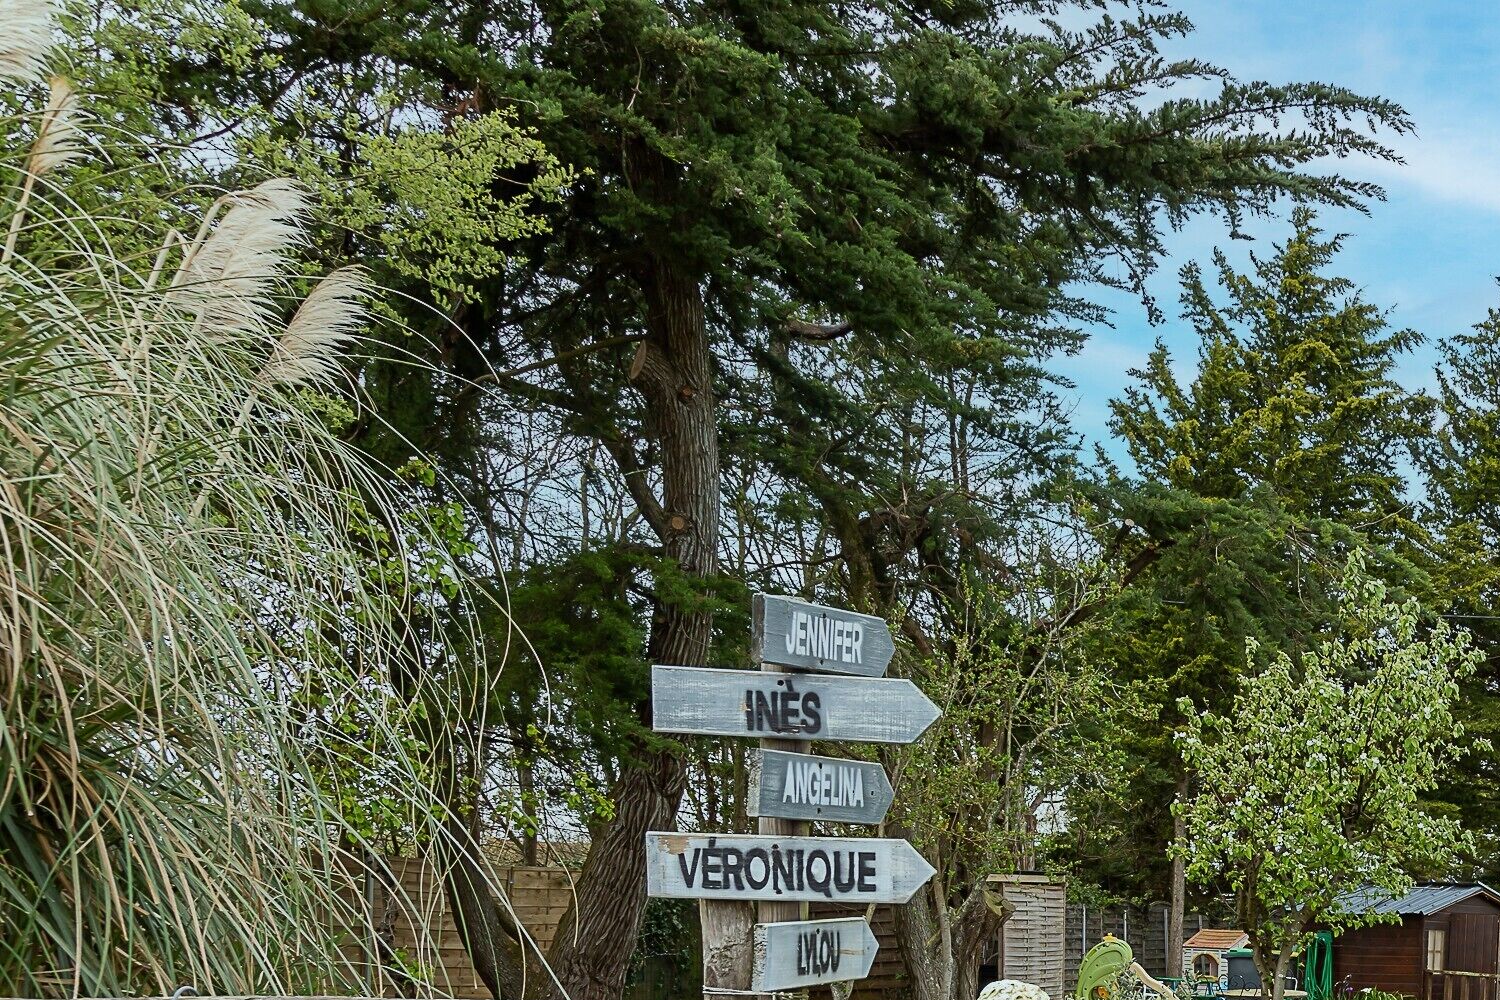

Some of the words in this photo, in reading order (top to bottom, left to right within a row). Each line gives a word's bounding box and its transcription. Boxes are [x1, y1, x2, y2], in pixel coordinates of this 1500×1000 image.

[785, 611, 863, 664] JENNIFER
[746, 678, 822, 735] INÈS
[782, 761, 865, 808] ANGELINA
[678, 837, 877, 898] VÉRONIQUE
[797, 929, 841, 976] LYLOU
